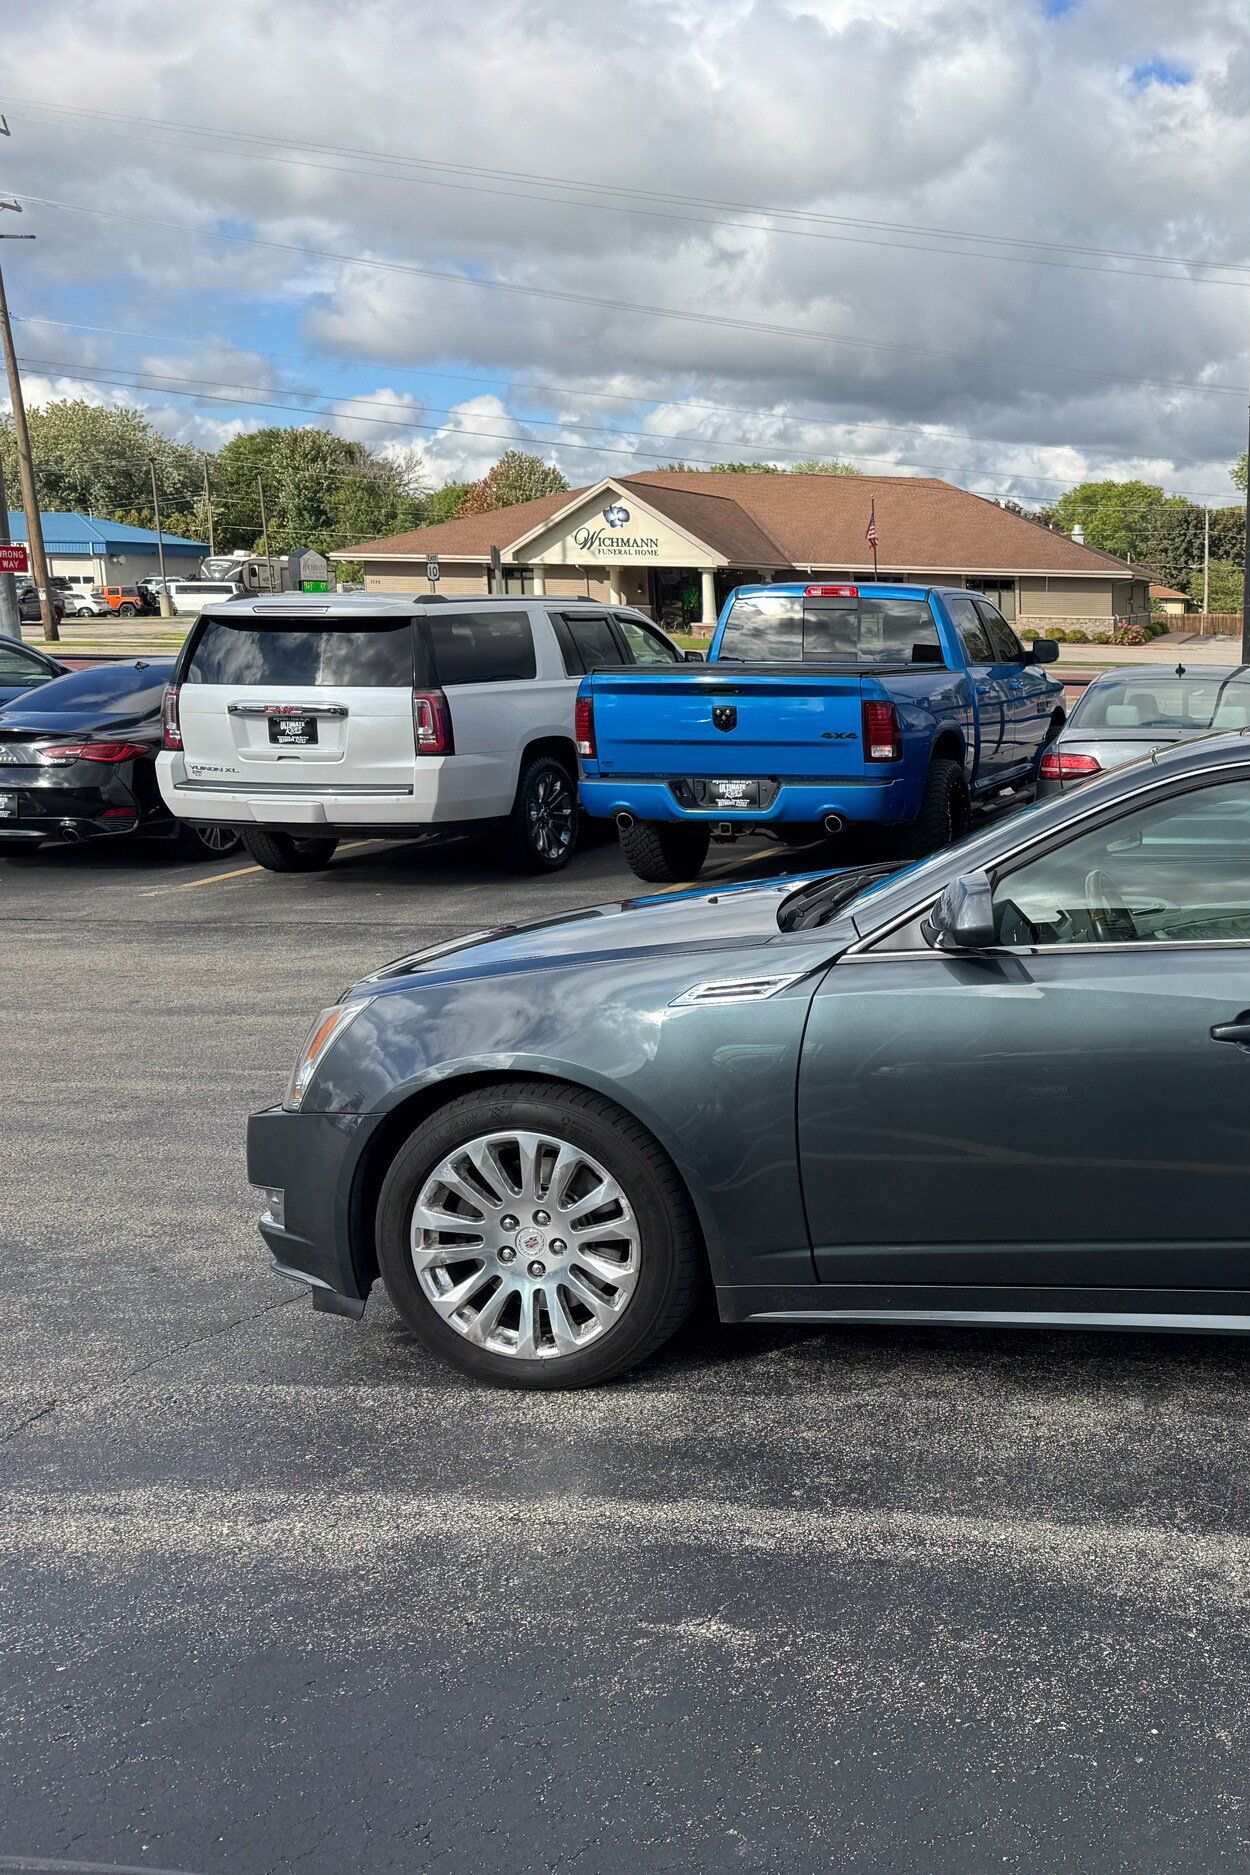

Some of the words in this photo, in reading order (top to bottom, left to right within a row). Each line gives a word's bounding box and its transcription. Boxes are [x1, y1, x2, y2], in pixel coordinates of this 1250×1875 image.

[574, 527, 659, 550] WICHMANN
[0, 550, 24, 559] RONG
[598, 548, 633, 556] FUNERAL
[634, 549, 659, 557] HOME
[1, 560, 19, 569] WAY
[428, 566, 438, 577] 10
[189, 764, 224, 772] YUKON
[719, 783, 747, 793] ULTIMATE
[444, 1112, 479, 1134] SEASON
